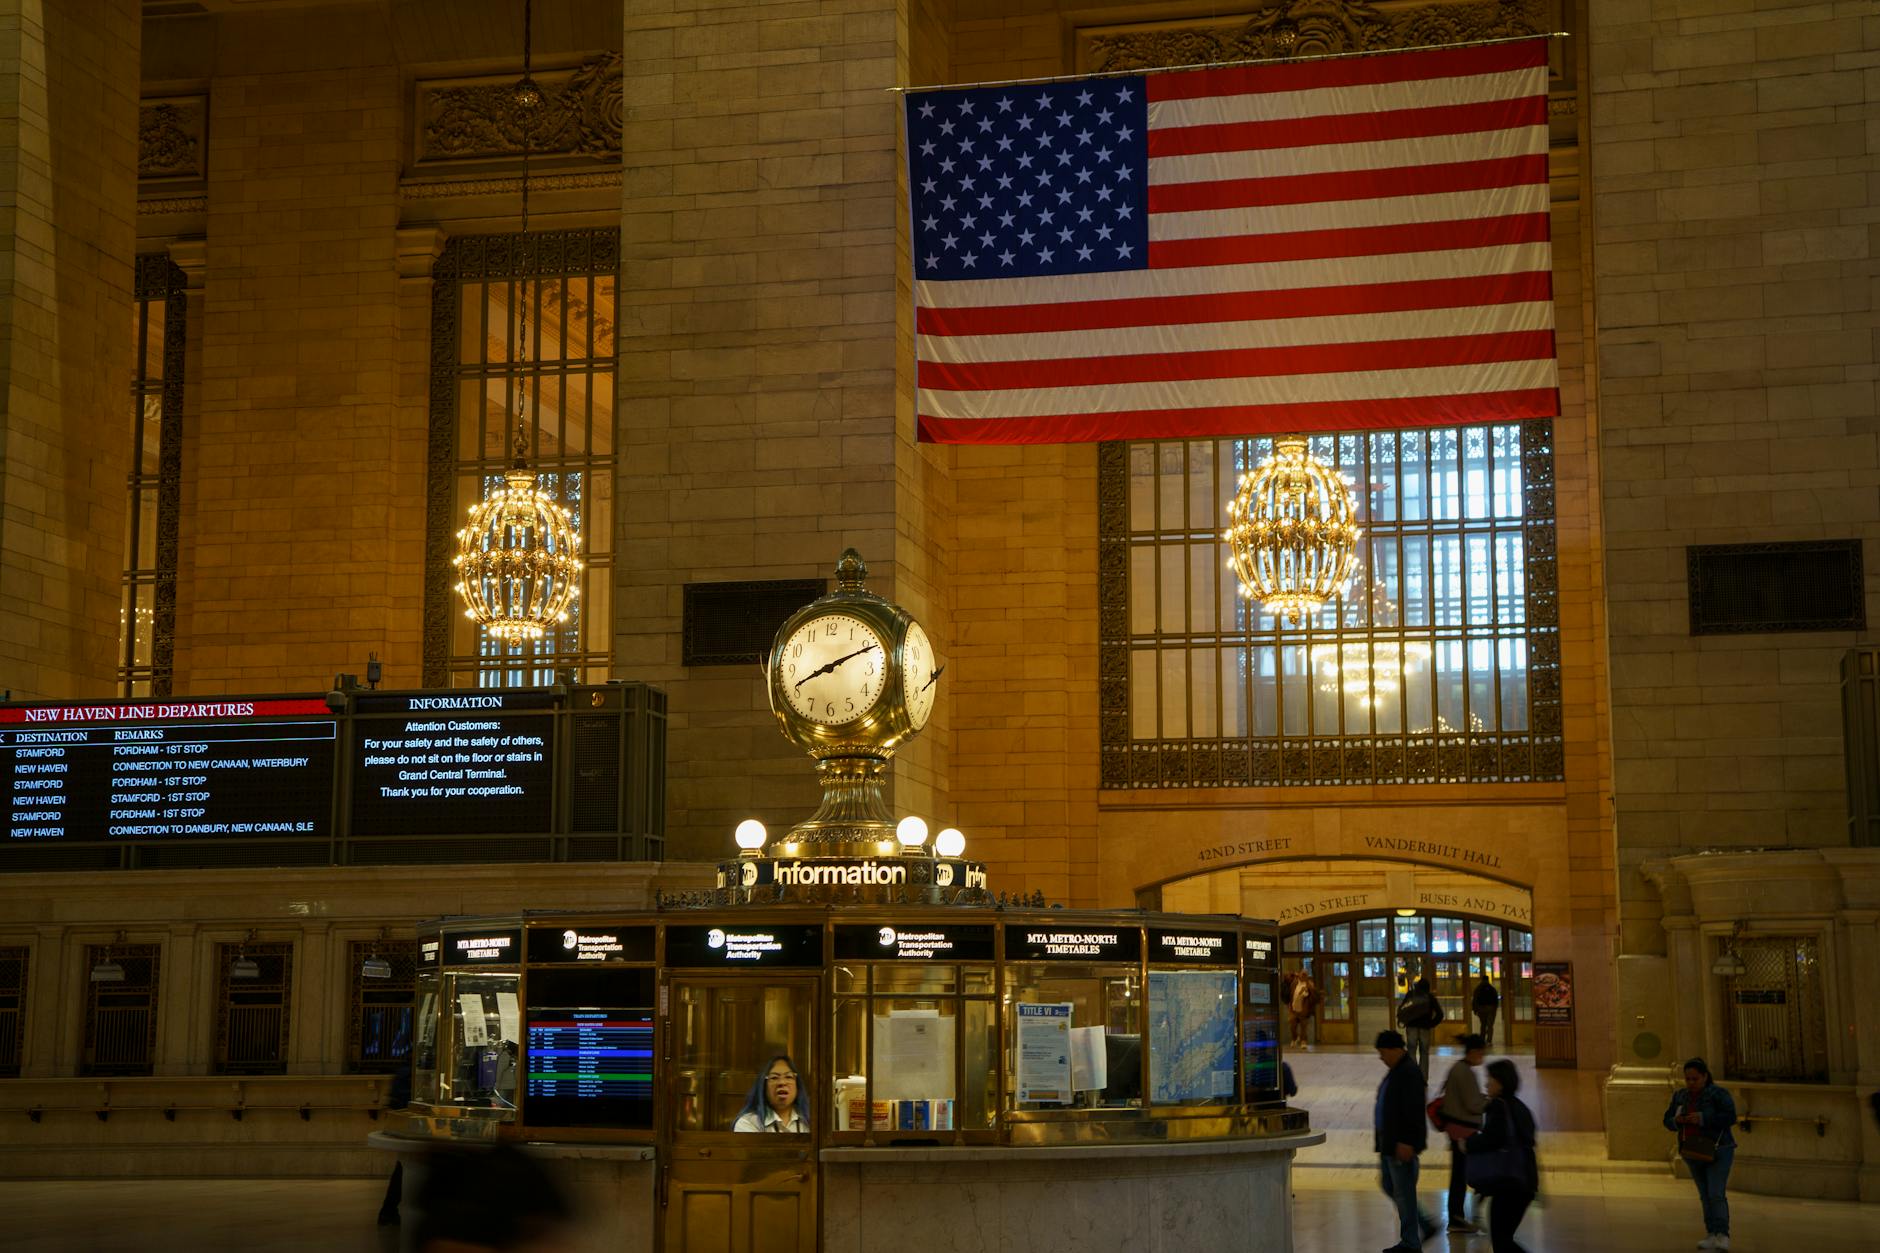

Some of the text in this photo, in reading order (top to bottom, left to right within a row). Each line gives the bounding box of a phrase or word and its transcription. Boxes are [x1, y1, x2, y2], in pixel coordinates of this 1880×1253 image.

[826, 622, 838, 636] 12
[850, 628, 854, 641] 1
[807, 630, 816, 643] 11
[792, 644, 802, 658] 10
[788, 665, 796, 678] 9
[864, 662, 874, 676] 3
[794, 686, 801, 699] 8
[860, 682, 870, 696] 4
[409, 696, 502, 710] INFORMATION
[808, 698, 815, 712] 7
[844, 697, 854, 712] 5
[25, 703, 254, 722] NEW HAVEN LINE DEPARTURES
[826, 702, 835, 717] 6
[405, 720, 500, 732] Attention Customers:
[16, 732, 88, 743] DESTINATION
[114, 730, 164, 741] REMARKS
[364, 735, 544, 750] For your safety and the safety of others,
[16, 748, 65, 758] STAMFORD
[114, 746, 158, 756] FORDHAM
[166, 745, 182, 754] 1ST
[184, 744, 208, 754] STOP
[113, 758, 308, 772] CONNECTION TO NEW CANAAN, WATERBURY
[364, 755, 396, 766] please
[398, 755, 410, 764] do
[412, 754, 426, 764] not
[428, 754, 440, 764] sit
[442, 756, 453, 764] on
[455, 754, 470, 763] the
[472, 753, 492, 762] floor
[507, 752, 532, 762] stairs
[534, 752, 542, 762] in
[15, 764, 68, 774] NEW HAVEN
[399, 769, 506, 780] Grand Central Terminal.
[14, 780, 64, 790] STAMFORD
[112, 778, 157, 787] FORDHAM
[164, 777, 180, 786] 1ST
[182, 776, 207, 786] STOP
[111, 793, 161, 803] STAMFORD
[168, 792, 184, 802] 1ST
[186, 792, 210, 802] STOP
[380, 786, 524, 798] Thank you for your cooperation.
[13, 796, 66, 806] NEW HAVEN
[12, 812, 62, 822] STAMFORD
[110, 809, 156, 819] FORDHAM
[163, 808, 178, 818] 1ST
[180, 808, 205, 818] STOP
[11, 828, 64, 838] NEW HAVEN
[110, 822, 314, 836] CONNECTION TO DANBURY, NEW CANAAN, SLE
[1198, 838, 1292, 862] 42ND STREET
[1365, 836, 1501, 868] VANDERBILT HALL
[774, 860, 906, 885] Information
[1280, 894, 1368, 921] 42ND STREET
[1420, 893, 1528, 920] BUSES AND TAX
[898, 932, 944, 942] Metropolitan
[1028, 934, 1118, 945] MTA METRO-NORTH
[1162, 936, 1222, 948] MTA METRO-NORTH
[578, 944, 622, 952] Transportation
[898, 941, 952, 950] Transportation
[1046, 944, 1100, 954] TIMETABLES
[1174, 946, 1211, 956] TIMETABLES
[467, 948, 500, 958] TIMETABLES
[577, 952, 606, 960] Authority
[726, 951, 762, 960] Authority
[898, 949, 934, 958] Authority
[1023, 1006, 1042, 1016] TITLE
